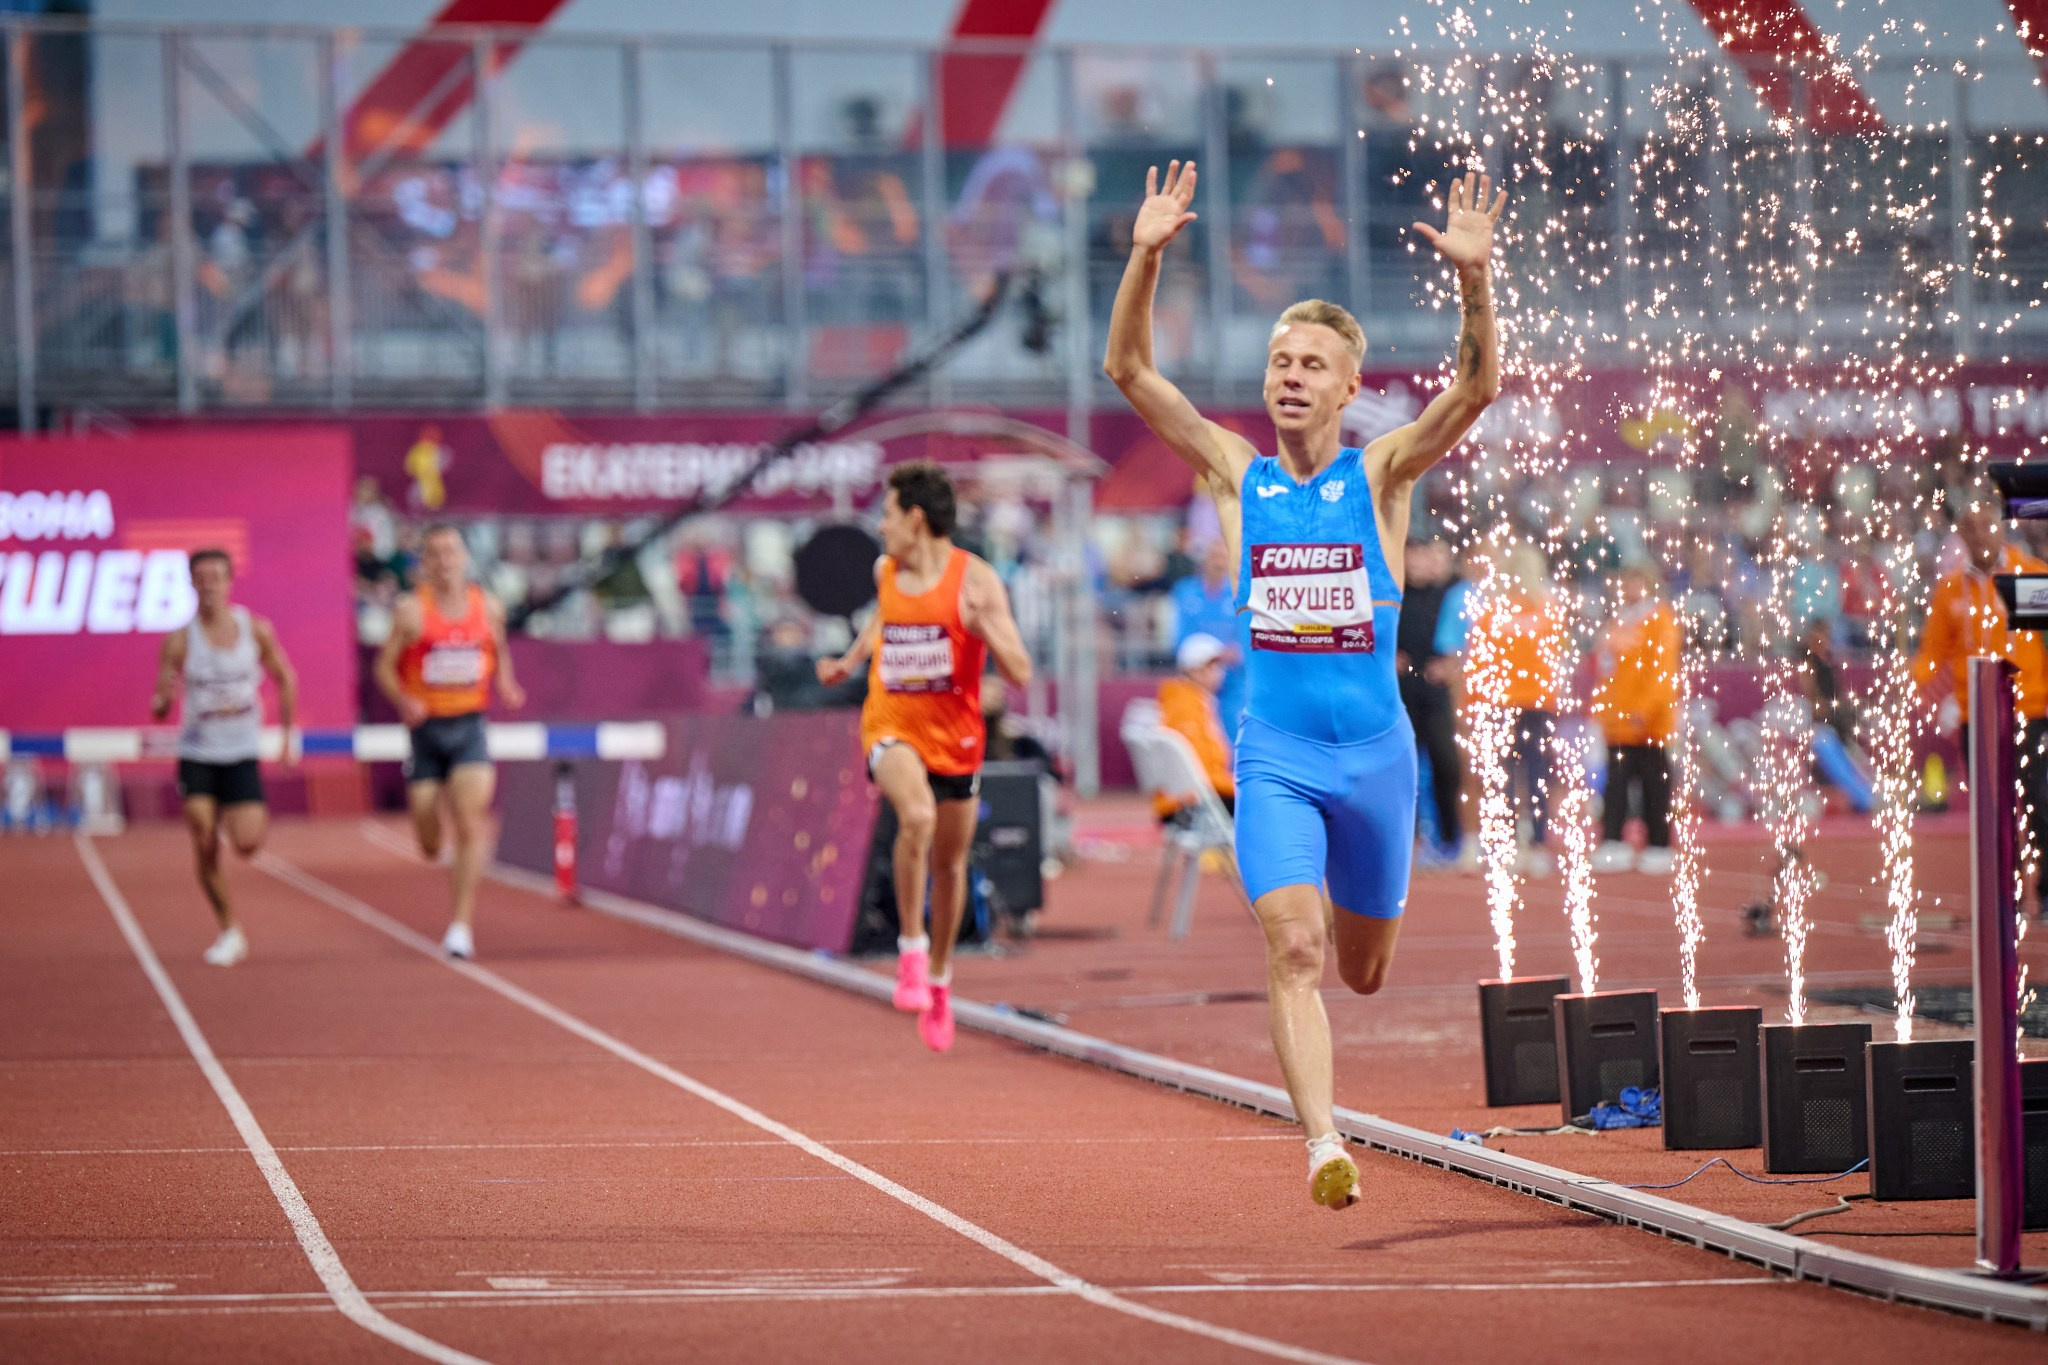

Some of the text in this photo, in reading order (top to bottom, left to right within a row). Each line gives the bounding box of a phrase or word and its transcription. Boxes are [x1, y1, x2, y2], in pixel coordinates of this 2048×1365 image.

[1260, 547, 1354, 569] FONBET
[0, 549, 199, 634] ШЕВ
[1266, 587, 1354, 611] ЯКУШЕВ
[1300, 636, 1334, 644] СПОРТА
[1342, 640, 1367, 648] ВФЛА
